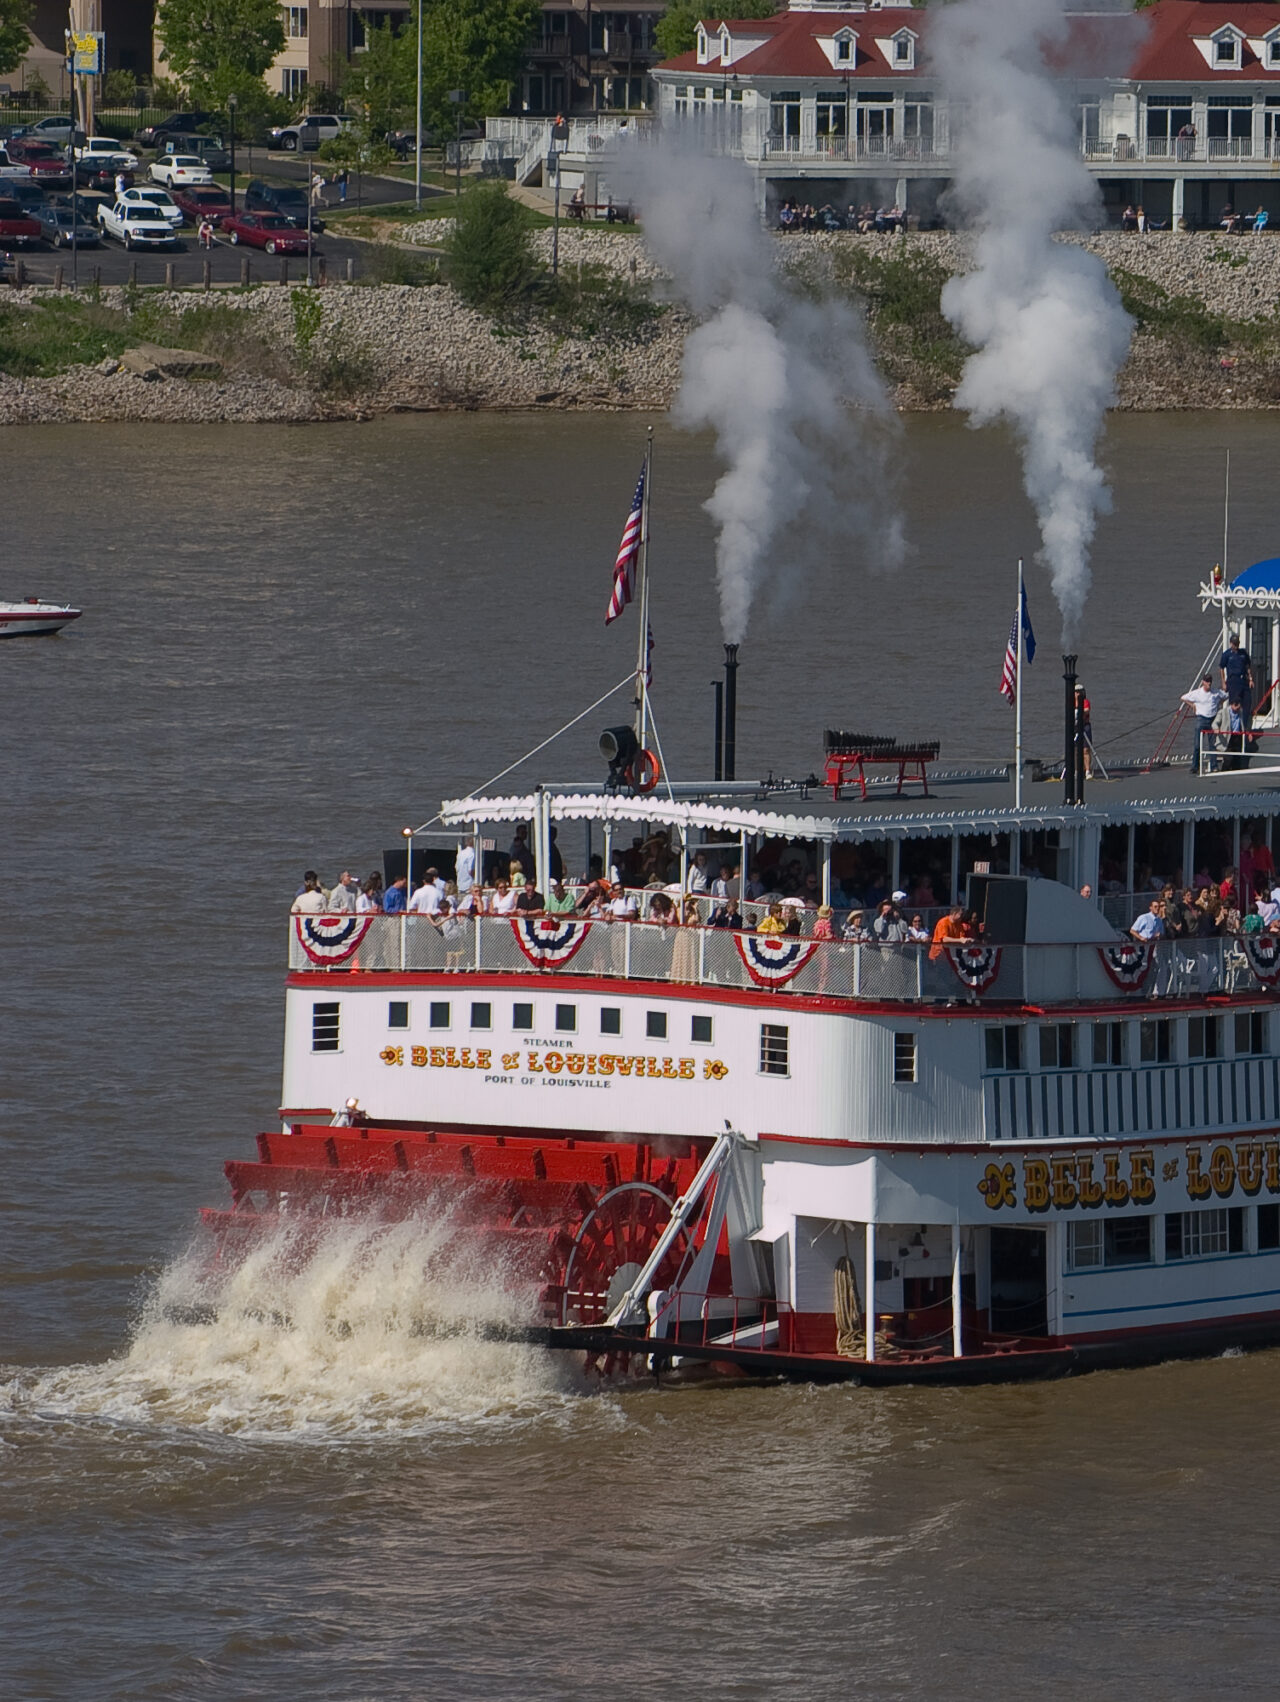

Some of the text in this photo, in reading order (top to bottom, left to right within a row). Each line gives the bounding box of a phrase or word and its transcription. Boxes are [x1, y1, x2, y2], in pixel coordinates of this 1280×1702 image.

[523, 1038, 573, 1048] STEAMER
[410, 1045, 491, 1069] BELLE
[528, 1051, 695, 1079] LOUISVILLE
[485, 1075, 611, 1088] PORT OF LOUISVILLE
[1023, 1150, 1156, 1213] BELLE
